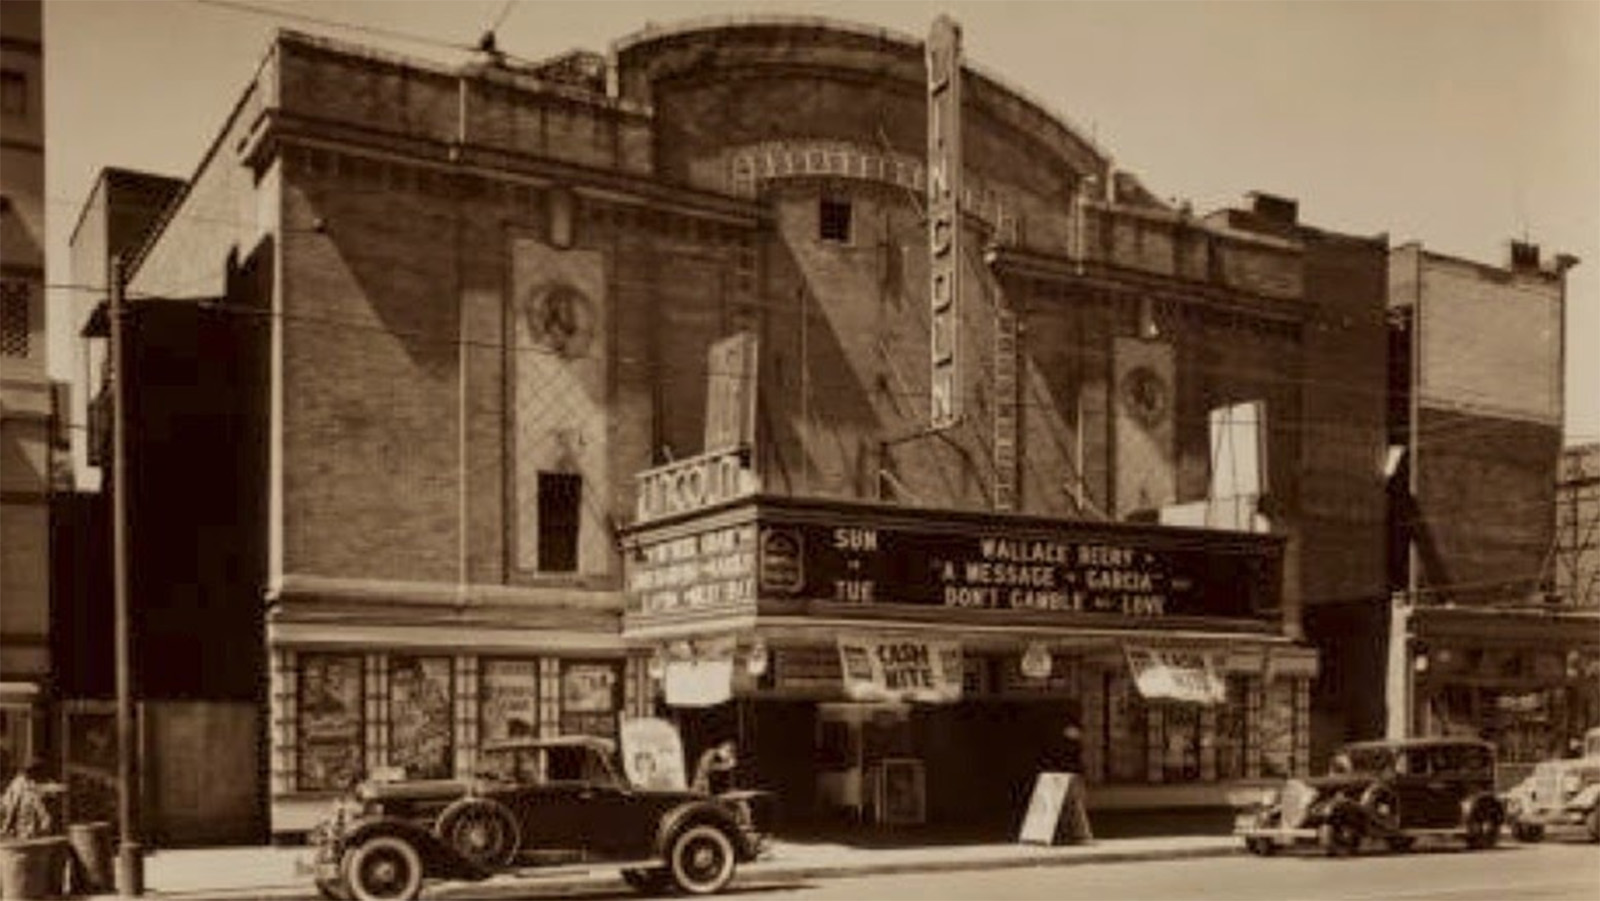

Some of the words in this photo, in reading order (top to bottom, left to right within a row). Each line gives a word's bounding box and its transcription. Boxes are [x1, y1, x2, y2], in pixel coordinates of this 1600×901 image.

[833, 528, 877, 551] SUN
[982, 539, 1068, 564] WALLACE
[965, 561, 1055, 587] MESSAGE
[835, 580, 874, 605] TUE
